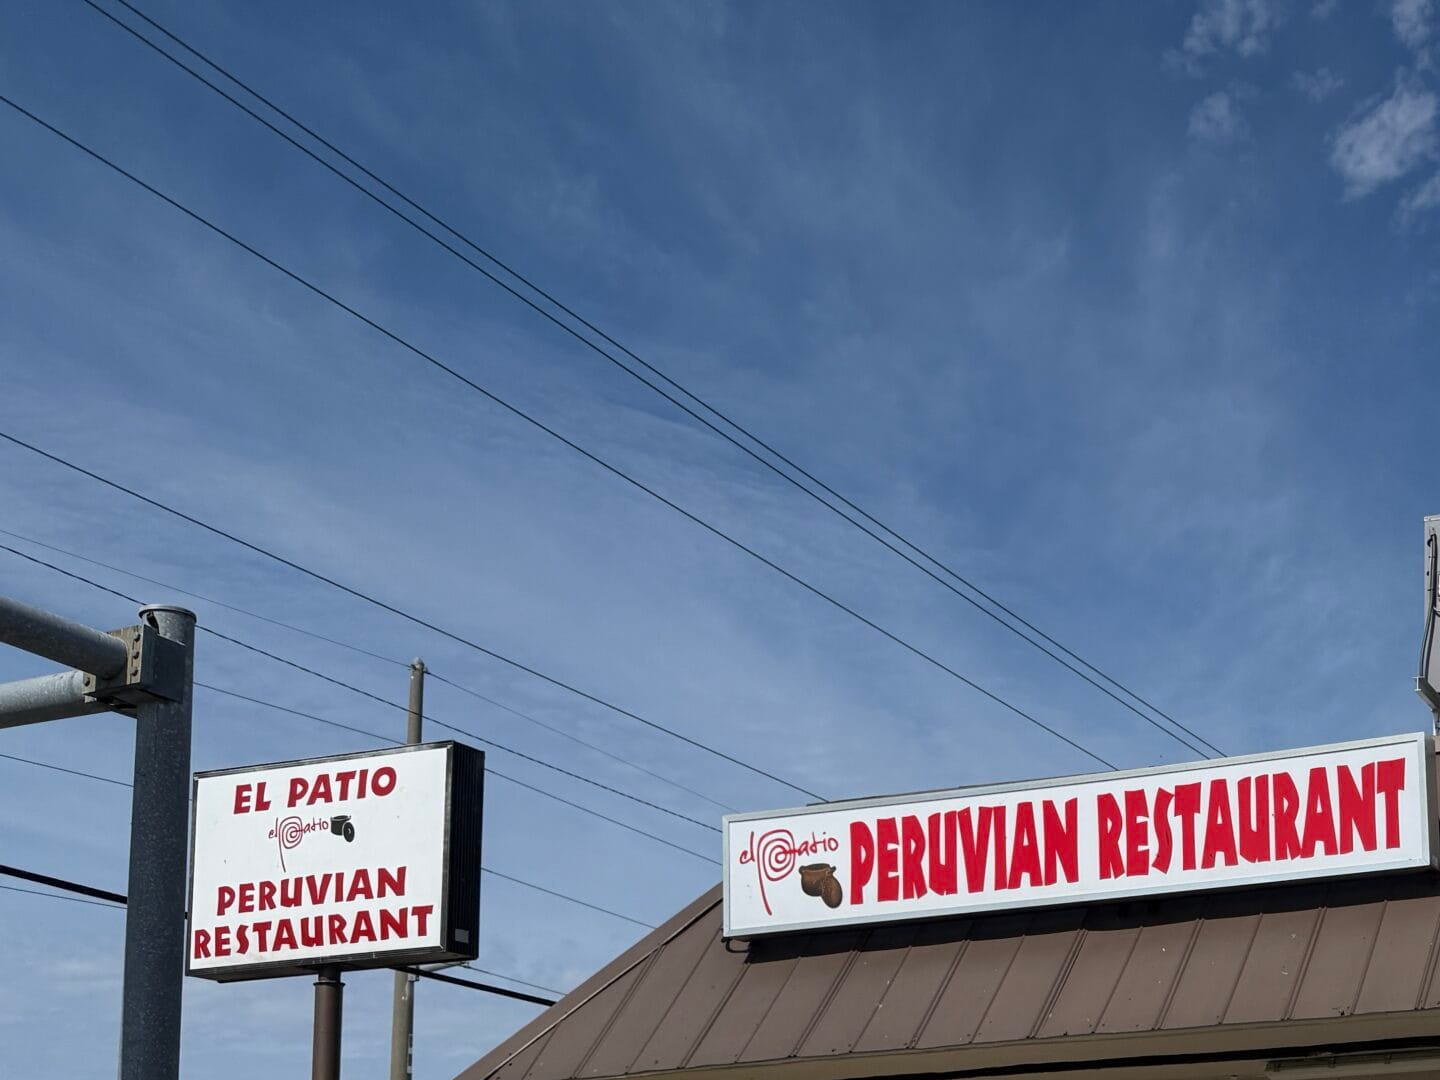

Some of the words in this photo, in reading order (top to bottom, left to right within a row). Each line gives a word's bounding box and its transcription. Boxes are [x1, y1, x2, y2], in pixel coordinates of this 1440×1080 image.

[233, 782, 271, 814] EL
[287, 766, 397, 808] PATIO
[850, 798, 1079, 905] PERUVIAN
[1097, 758, 1406, 880] RESTAURANT
[217, 866, 406, 916] PERUVIAN
[194, 905, 433, 959] RESTAURANT
